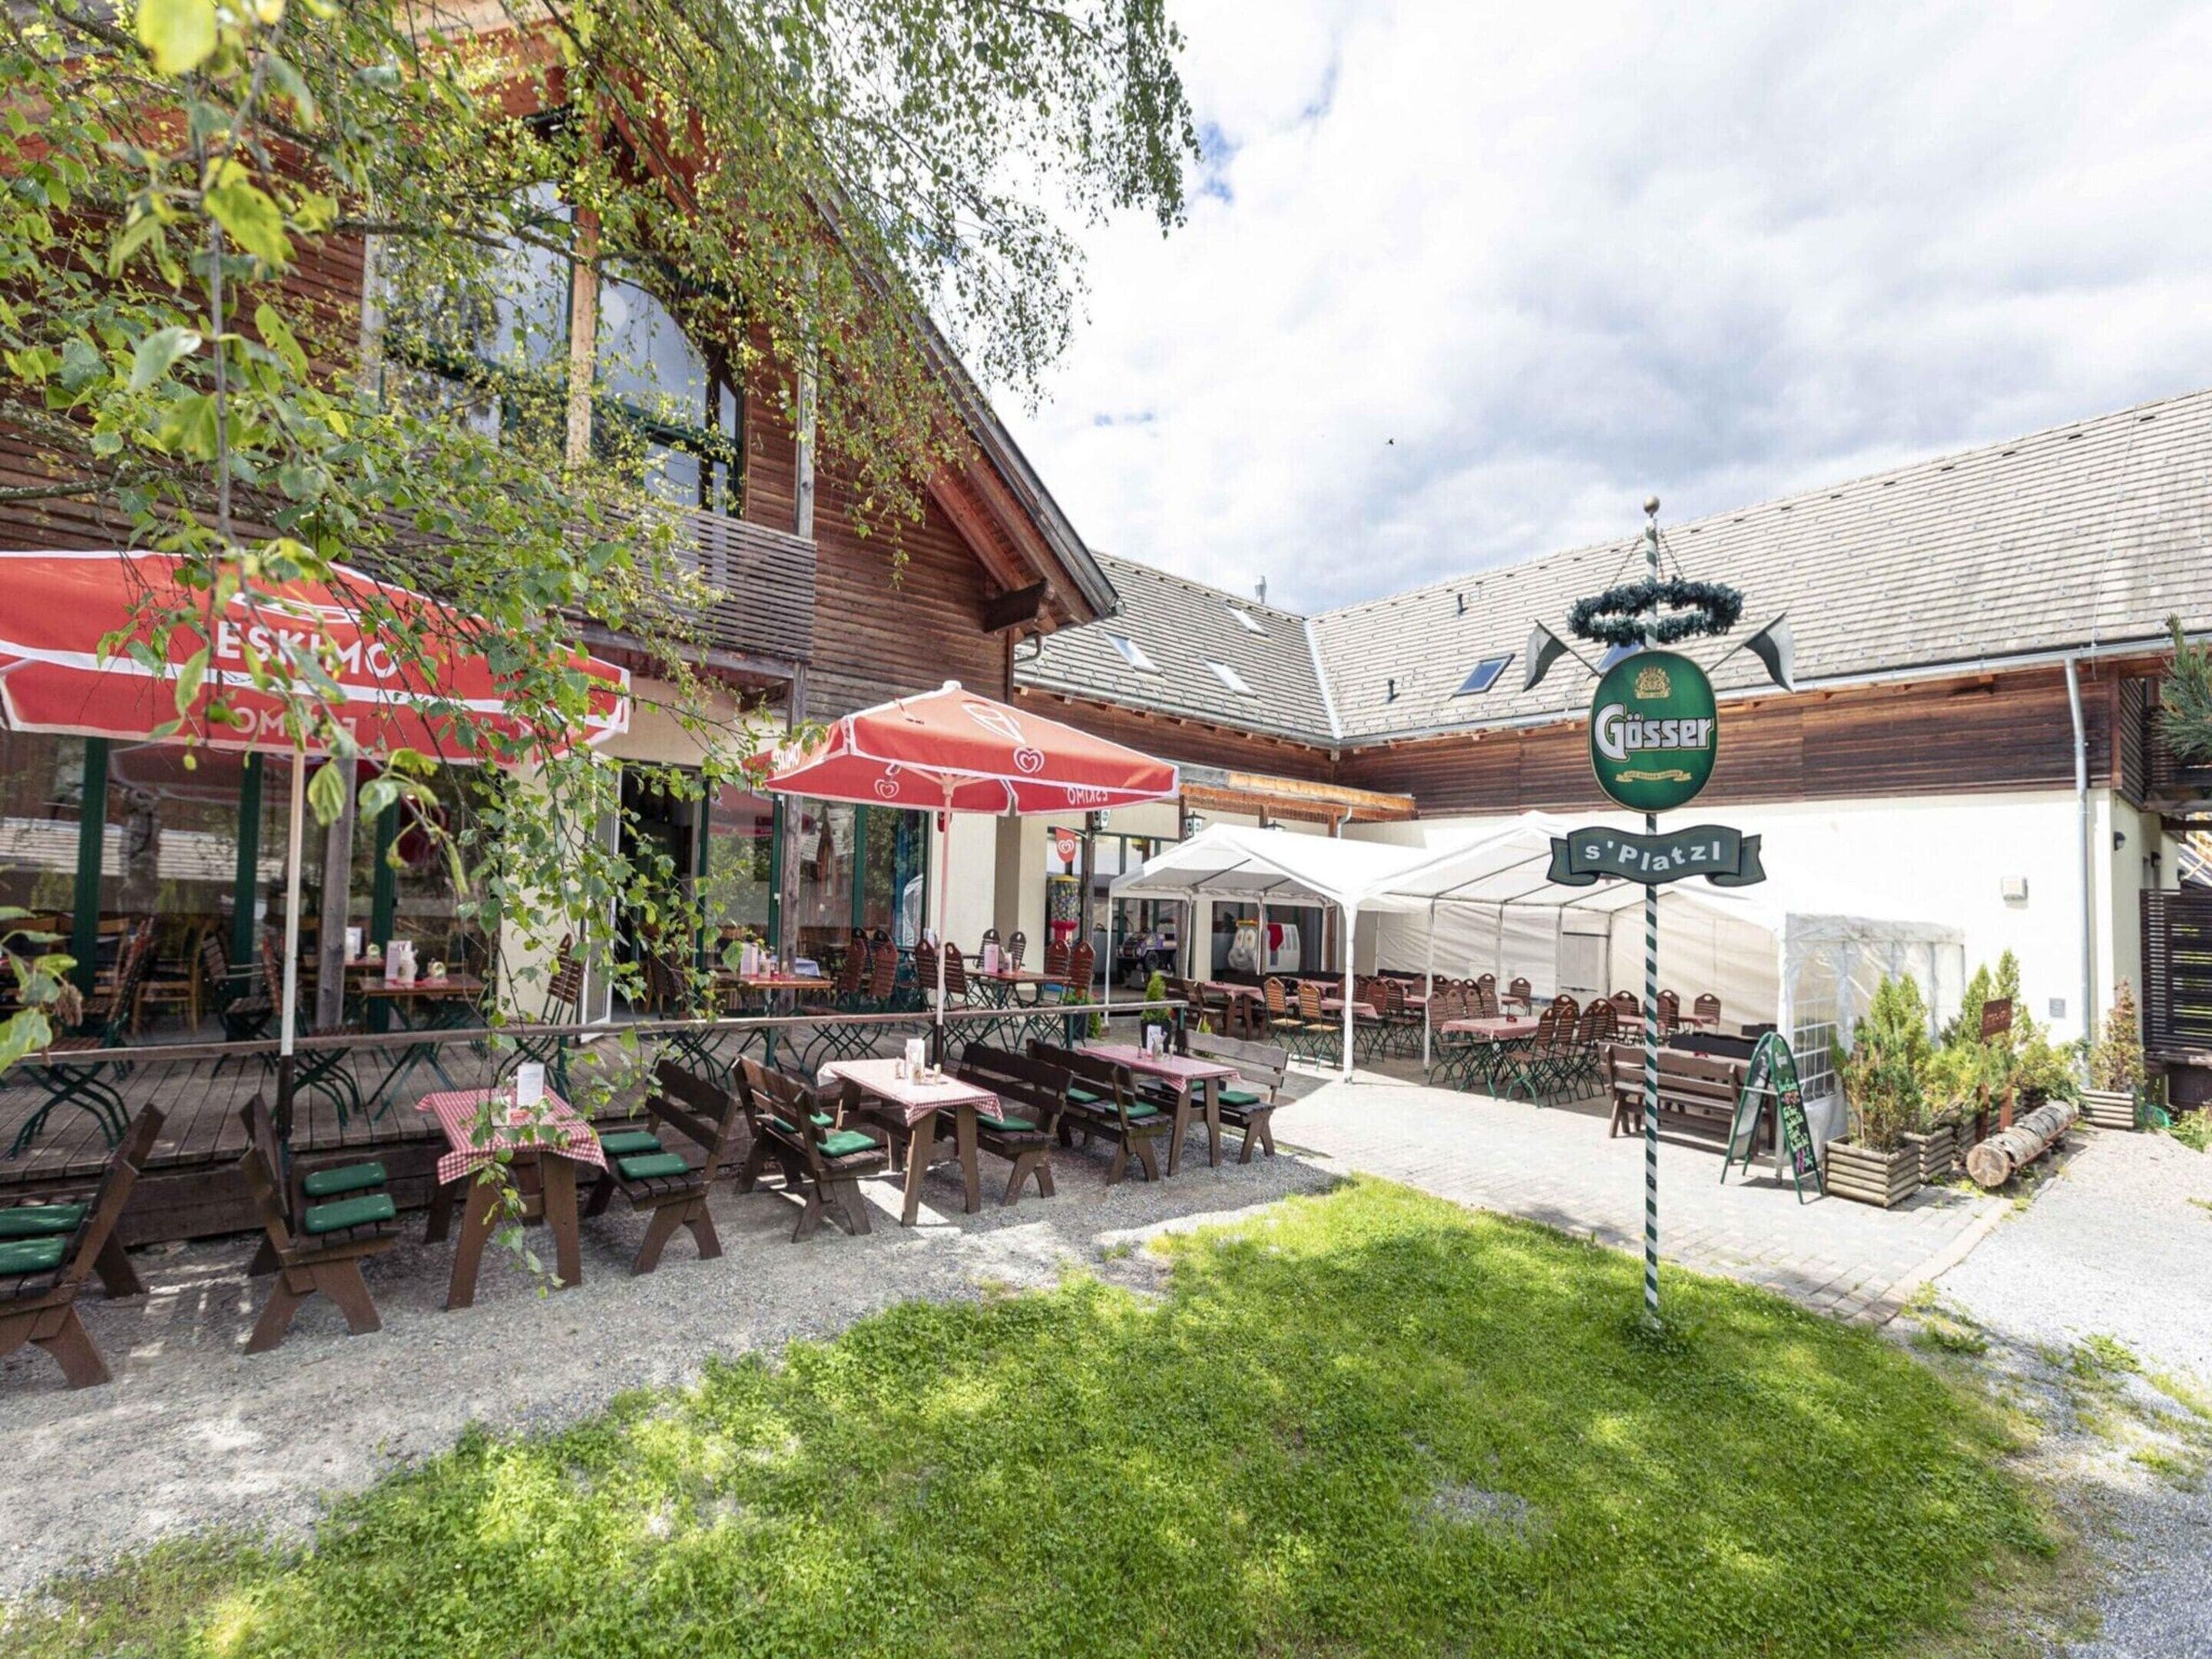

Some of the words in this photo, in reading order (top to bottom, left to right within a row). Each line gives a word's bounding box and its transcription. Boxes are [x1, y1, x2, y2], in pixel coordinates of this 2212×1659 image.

[217, 621, 399, 678] ESKIMO
[1594, 703, 1712, 760] Gösser
[1585, 841, 1720, 872] s'Platzl
